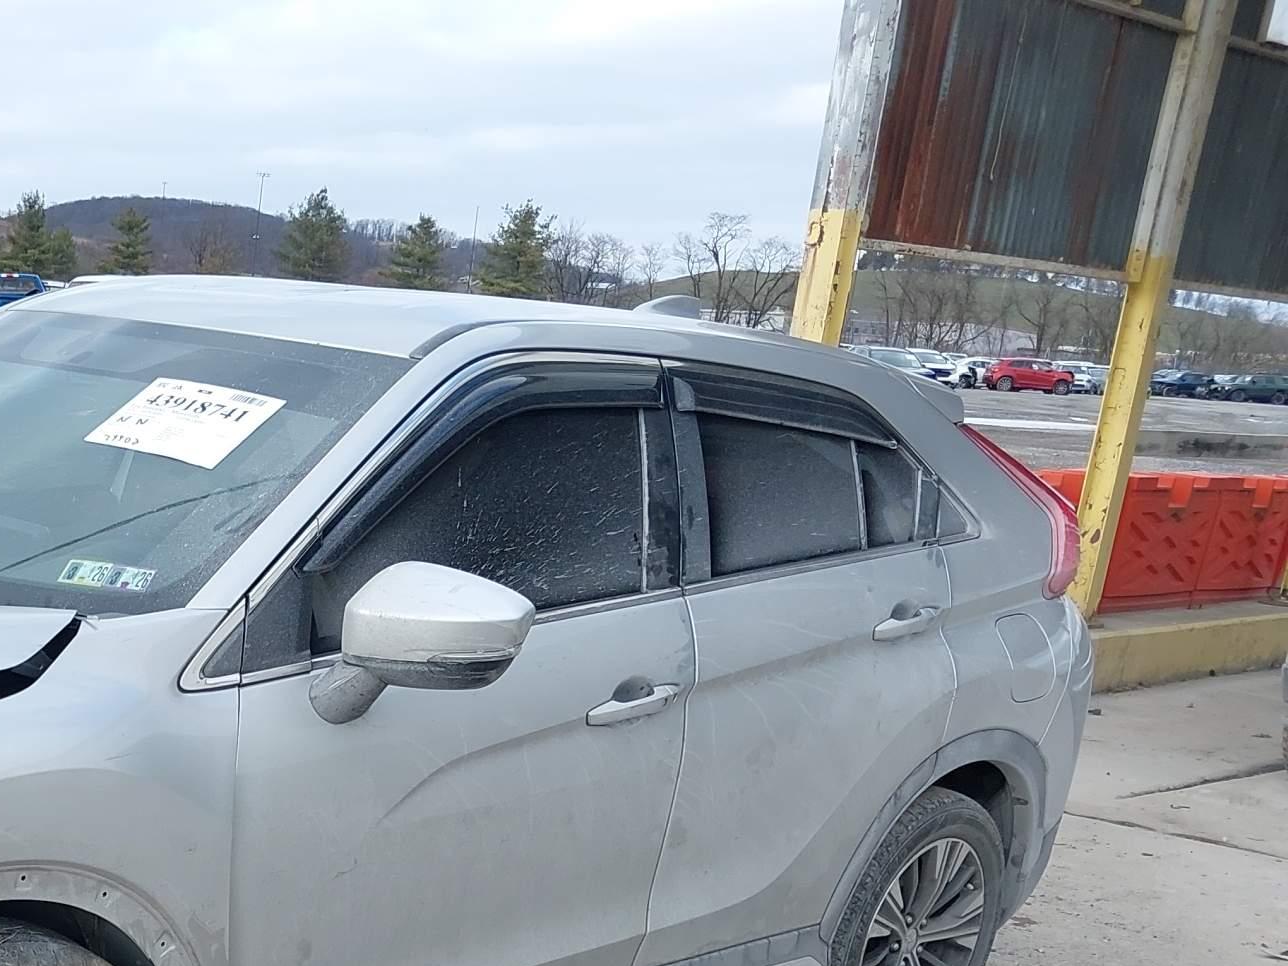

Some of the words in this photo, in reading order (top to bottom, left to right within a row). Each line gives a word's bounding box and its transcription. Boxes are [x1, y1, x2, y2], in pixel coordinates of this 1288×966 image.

[146, 393, 249, 422] 43918741
[91, 566, 109, 582] 26
[135, 572, 153, 588] 26
